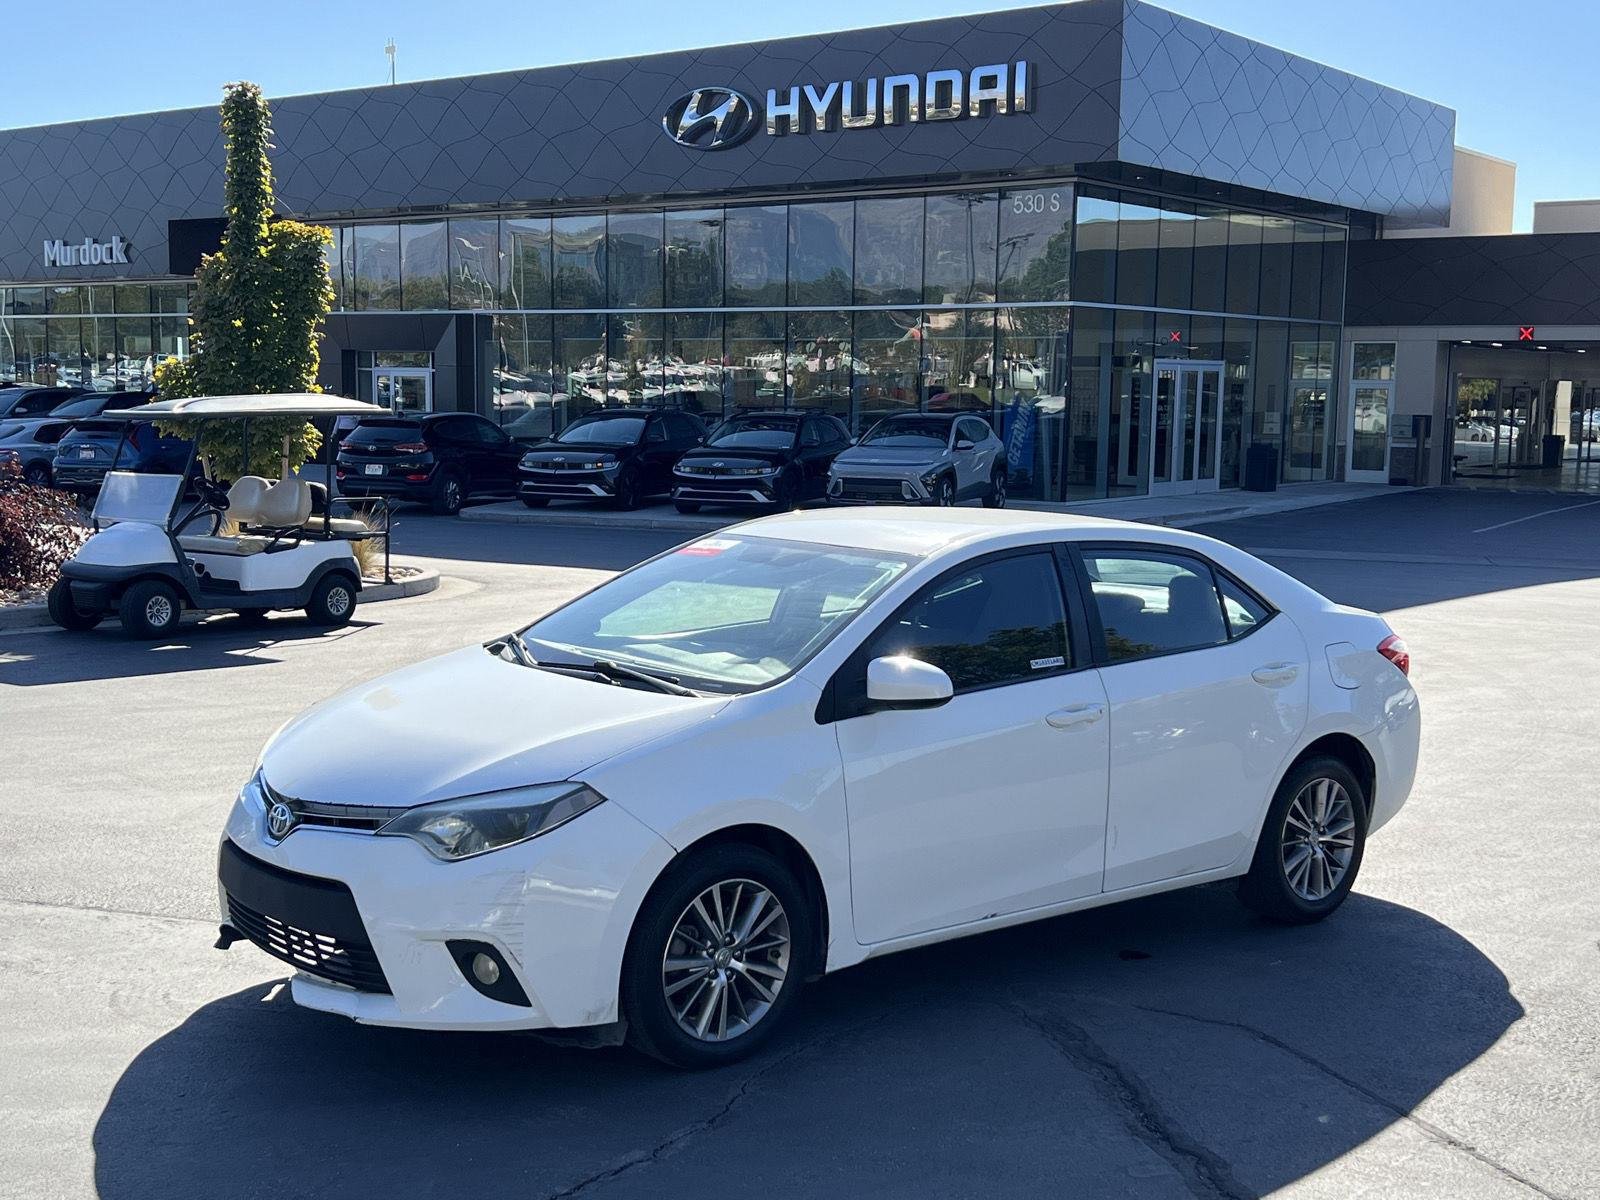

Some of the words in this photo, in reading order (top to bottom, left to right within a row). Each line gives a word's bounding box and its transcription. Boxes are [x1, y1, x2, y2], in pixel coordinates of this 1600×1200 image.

[766, 60, 1029, 136] HYUNDAI
[1013, 194, 1045, 214] 530
[1050, 192, 1060, 212] S
[43, 235, 128, 267] Murdock
